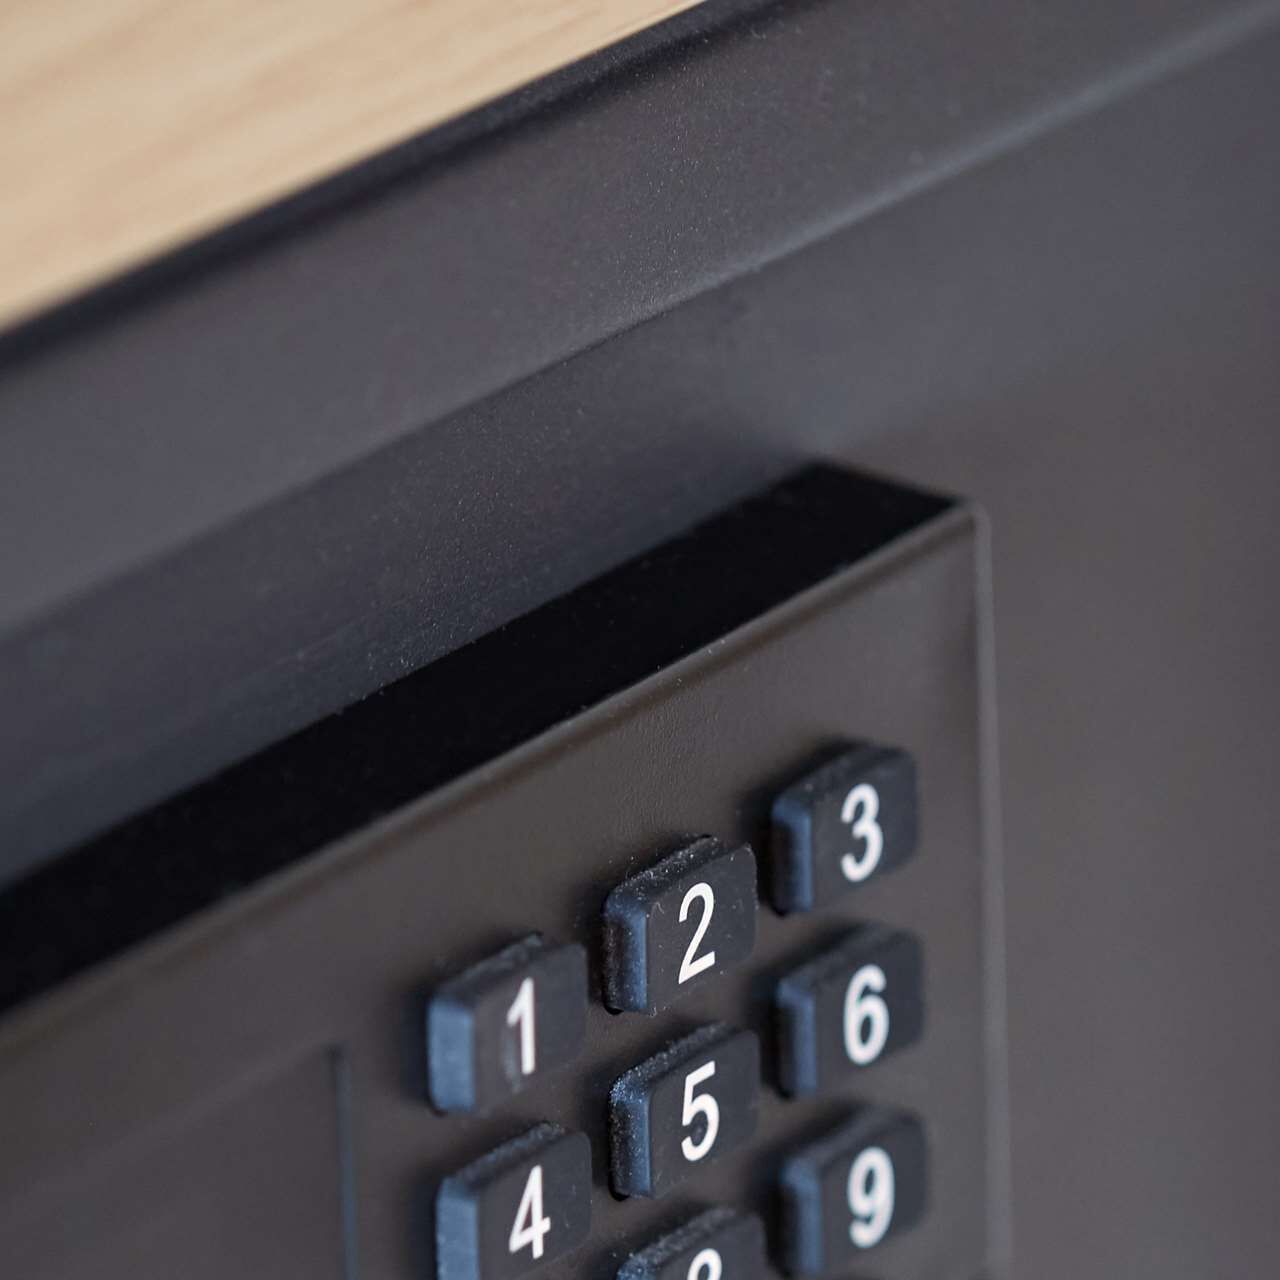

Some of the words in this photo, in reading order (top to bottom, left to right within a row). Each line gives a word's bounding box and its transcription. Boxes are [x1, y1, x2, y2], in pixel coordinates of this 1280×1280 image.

[840, 783, 884, 883] 3
[677, 882, 723, 985] 2
[506, 977, 536, 1075] 1
[843, 965, 890, 1065] 6
[681, 1060, 720, 1162] 5
[508, 1164, 552, 1260] 4
[847, 1146, 895, 1248] 9
